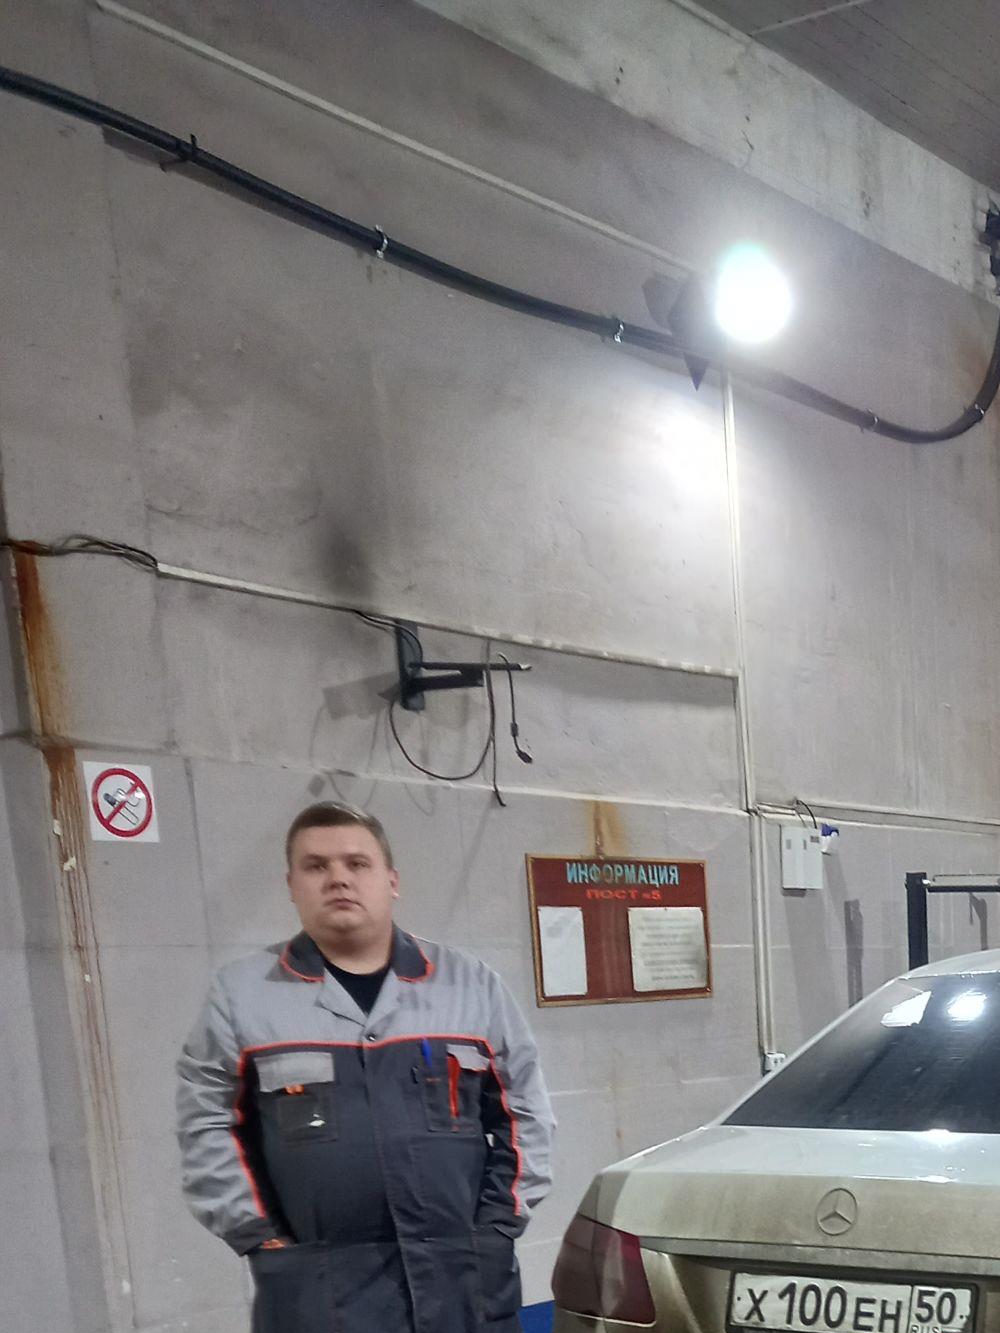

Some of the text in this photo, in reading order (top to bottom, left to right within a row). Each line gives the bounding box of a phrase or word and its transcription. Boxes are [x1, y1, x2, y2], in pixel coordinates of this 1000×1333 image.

[566, 862, 680, 888] ИНФОРМАЦИЯ
[586, 888, 639, 900] ПОСТ
[914, 1289, 957, 1325] 50
